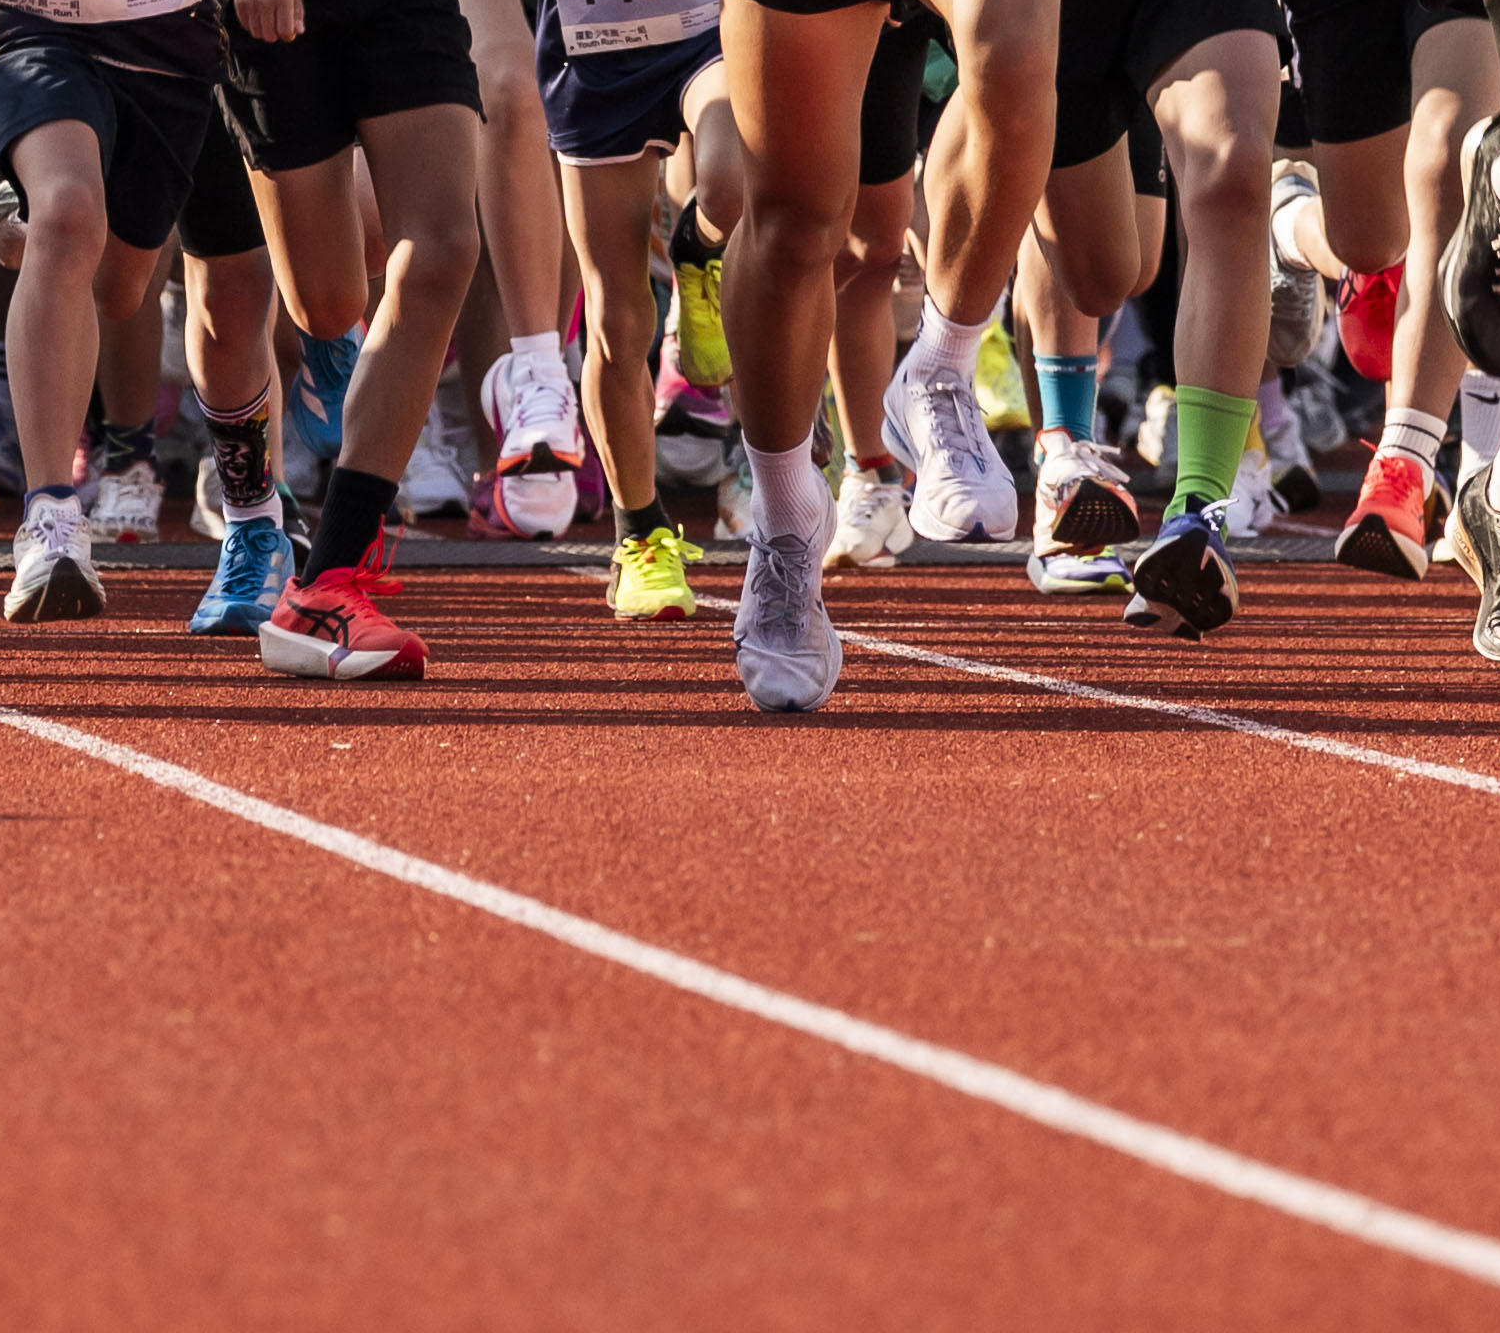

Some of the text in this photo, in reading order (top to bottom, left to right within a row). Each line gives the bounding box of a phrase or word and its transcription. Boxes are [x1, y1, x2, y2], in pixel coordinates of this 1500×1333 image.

[53, 6, 71, 18] Run
[73, 7, 80, 18] 1
[576, 37, 601, 50] Youth
[625, 35, 643, 45] Run
